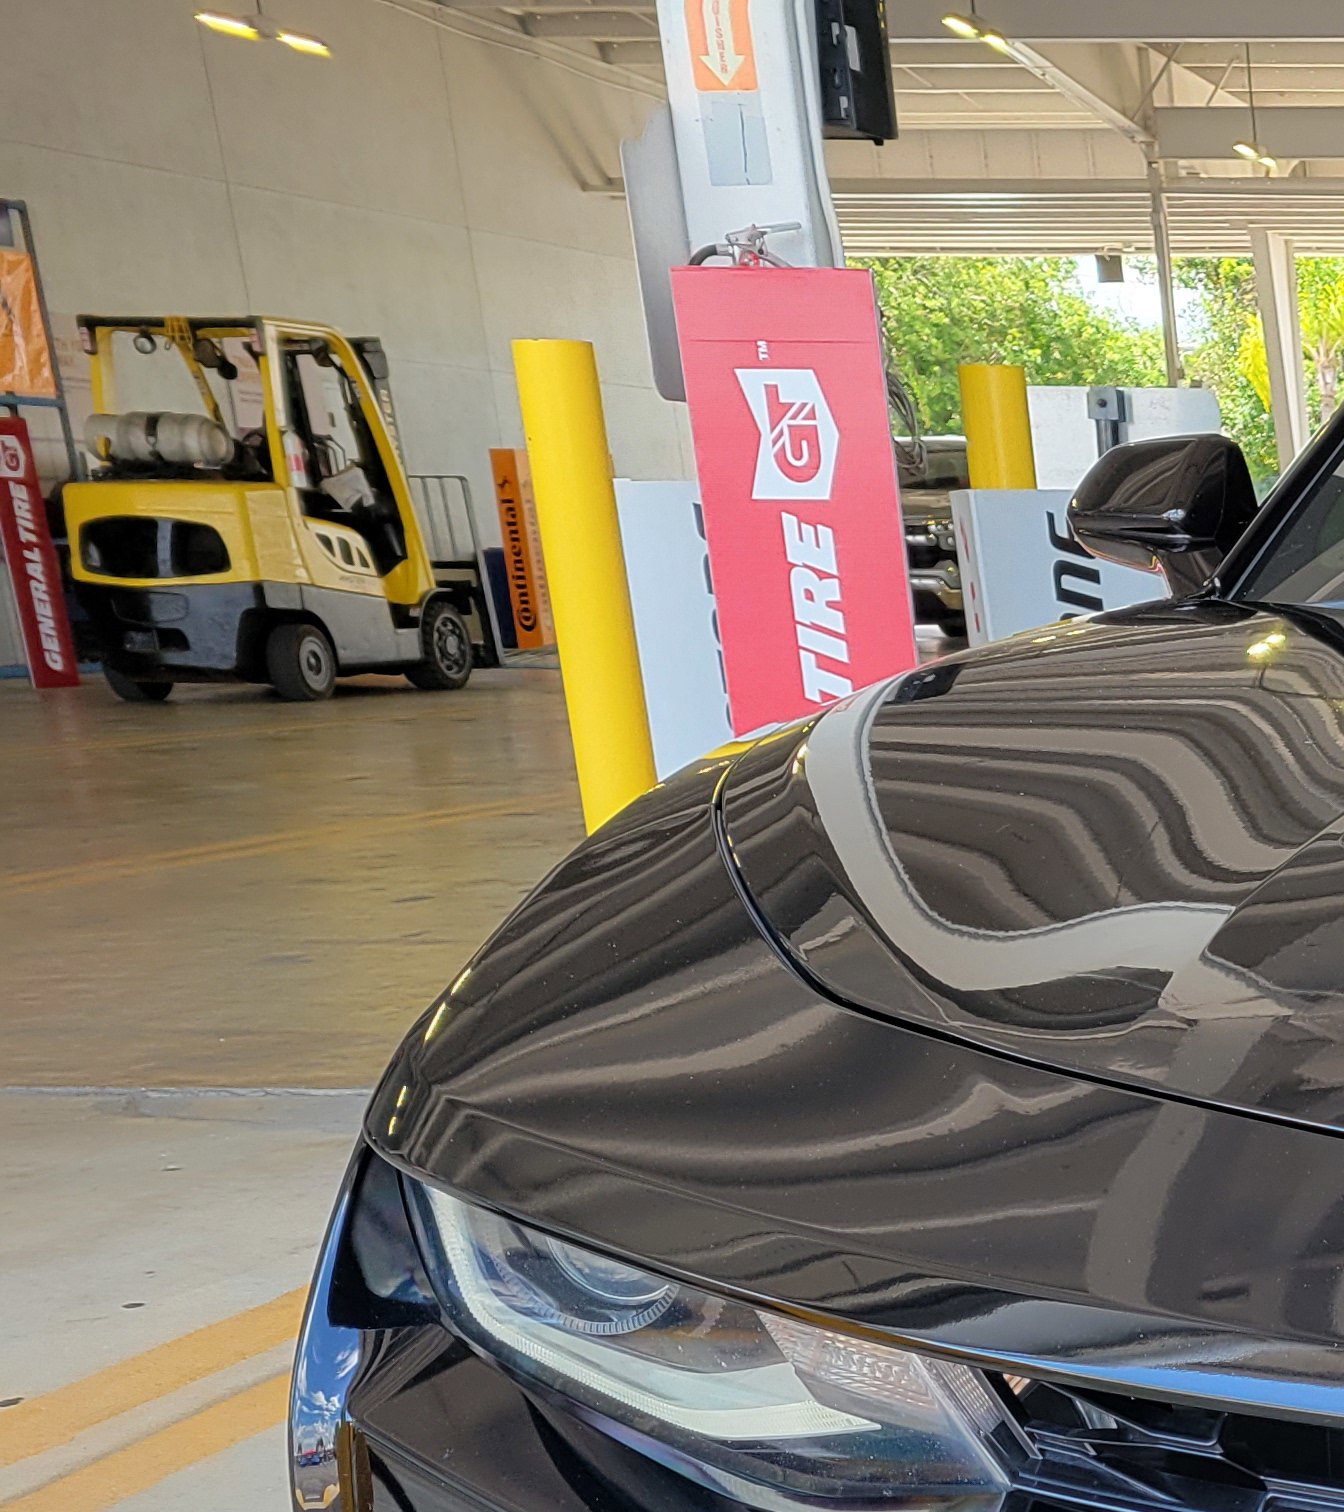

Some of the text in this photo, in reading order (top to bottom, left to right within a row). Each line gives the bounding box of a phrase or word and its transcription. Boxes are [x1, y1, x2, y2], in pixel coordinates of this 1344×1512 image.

[756, 340, 768, 361] TM
[8, 480, 65, 672] GENERAL TIRE
[501, 498, 537, 632] Continental
[781, 512, 854, 706] TIRE
